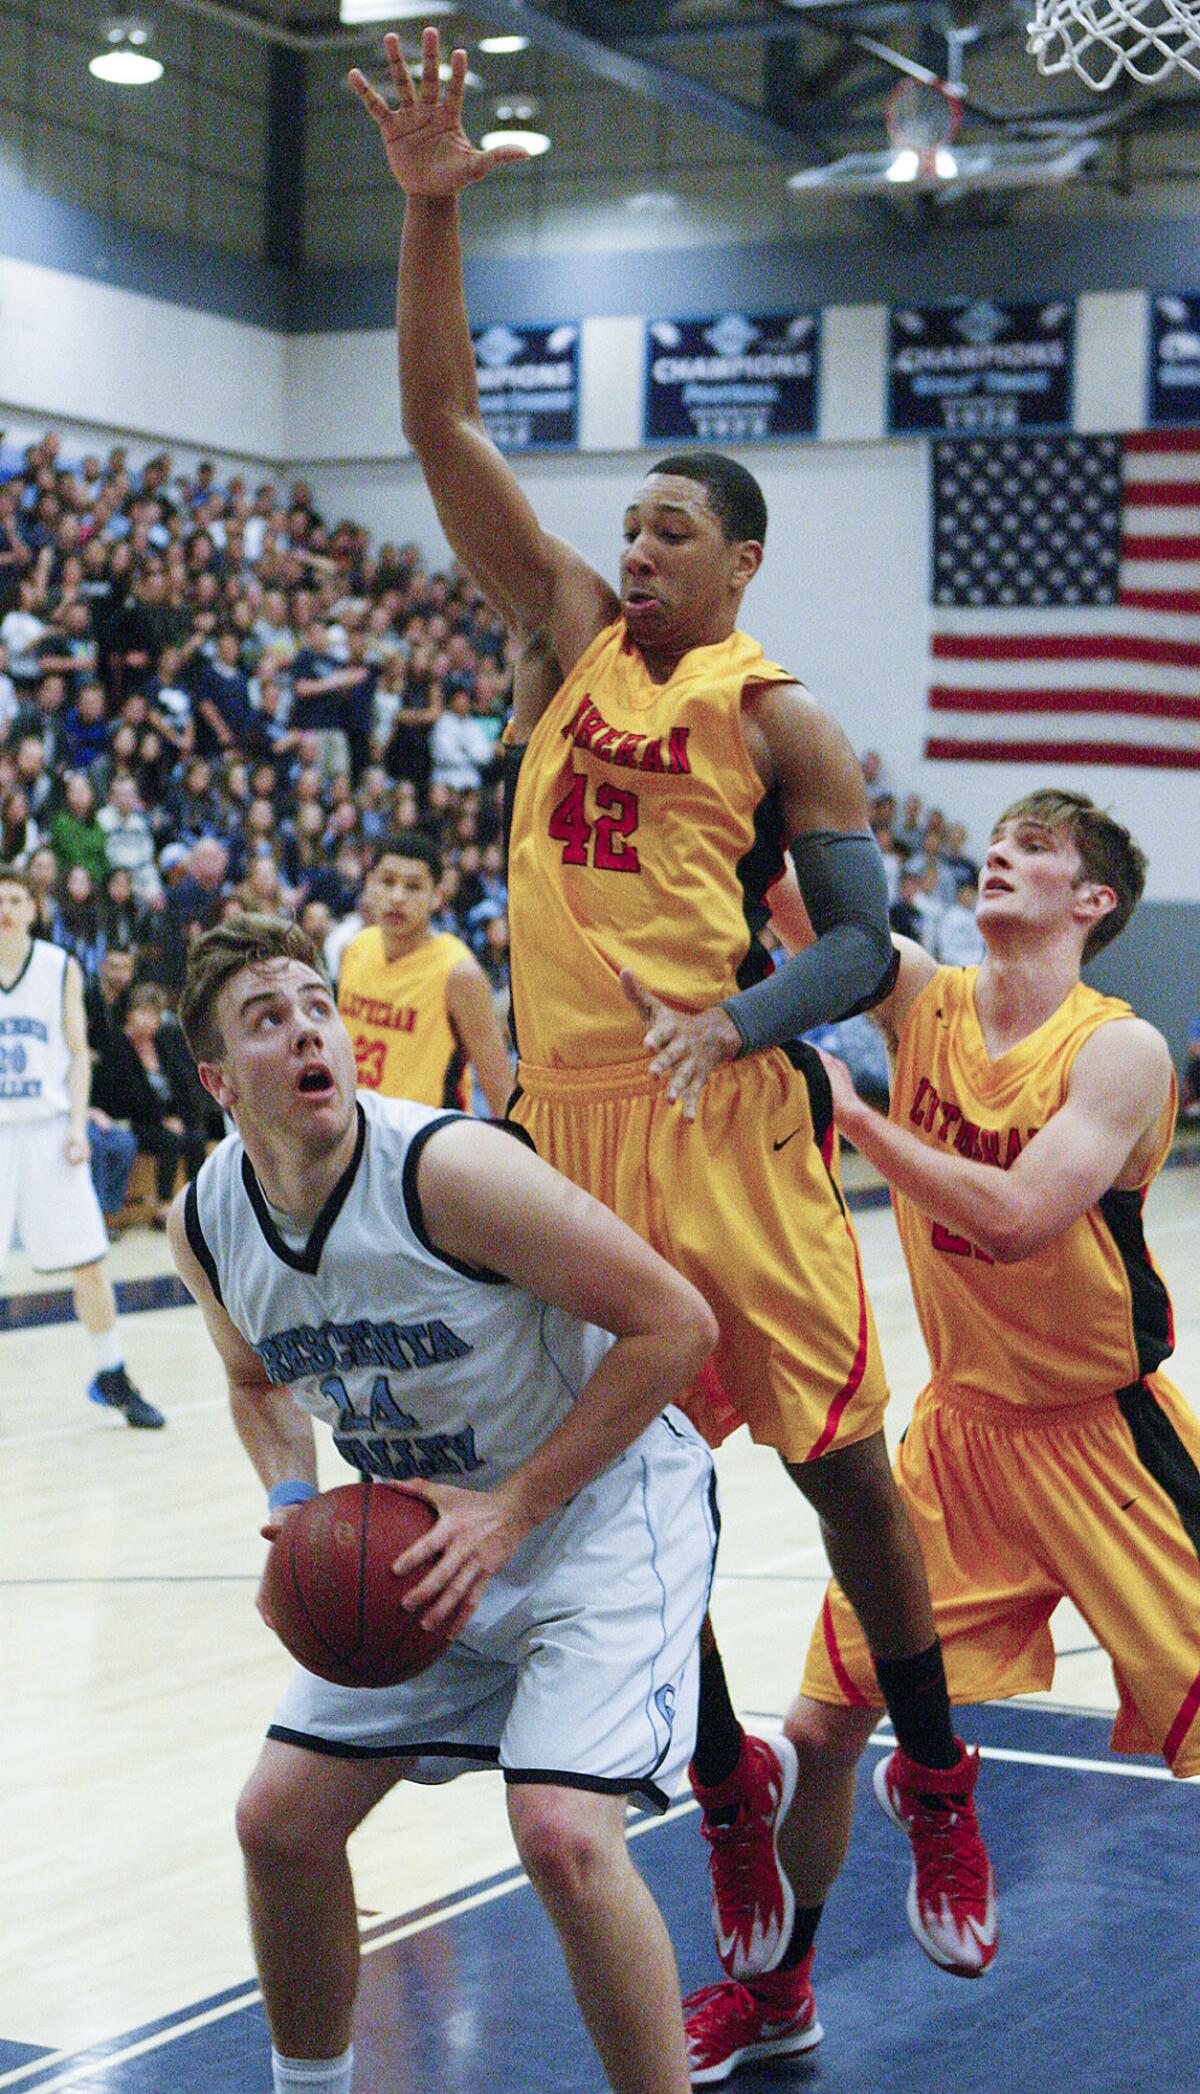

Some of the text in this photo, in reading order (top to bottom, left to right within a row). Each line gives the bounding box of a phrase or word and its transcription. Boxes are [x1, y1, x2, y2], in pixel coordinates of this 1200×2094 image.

[652, 352, 811, 384] CHAMPIONS
[896, 340, 1064, 372] CHAMPIONS
[548, 773, 641, 873] 42
[353, 1034, 387, 1088] 23
[320, 1375, 421, 1431] 14
